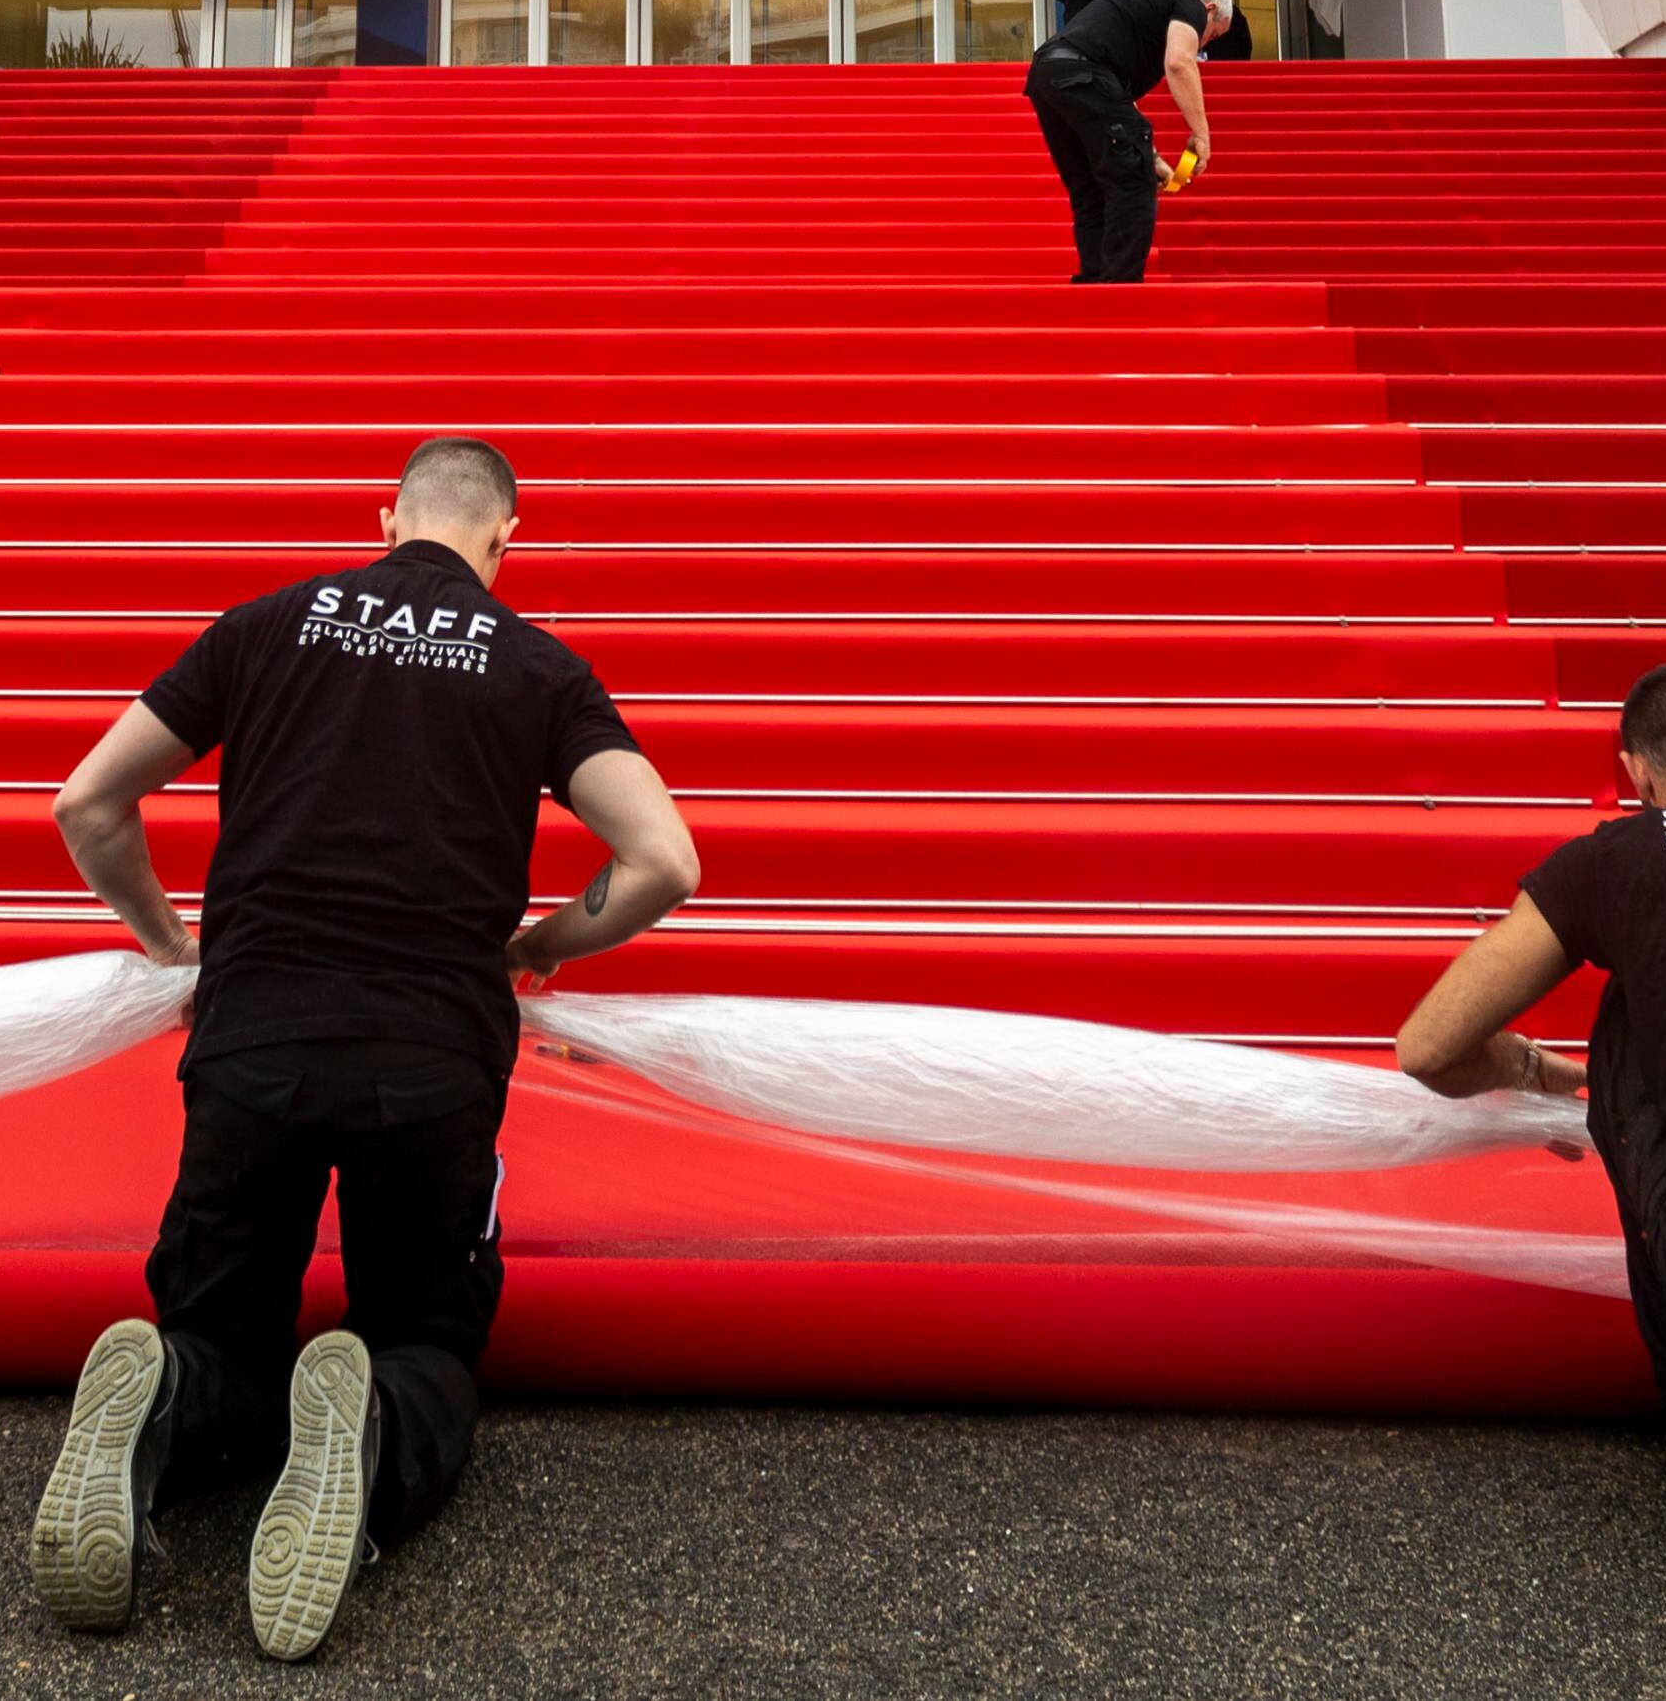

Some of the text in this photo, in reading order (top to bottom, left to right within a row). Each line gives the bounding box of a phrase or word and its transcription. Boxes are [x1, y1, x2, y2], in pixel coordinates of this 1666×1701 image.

[310, 586, 497, 640] STAFF
[298, 634, 320, 646] ET
[341, 639, 377, 657] DES
[301, 622, 361, 644] PALAIS
[368, 634, 395, 654] DS
